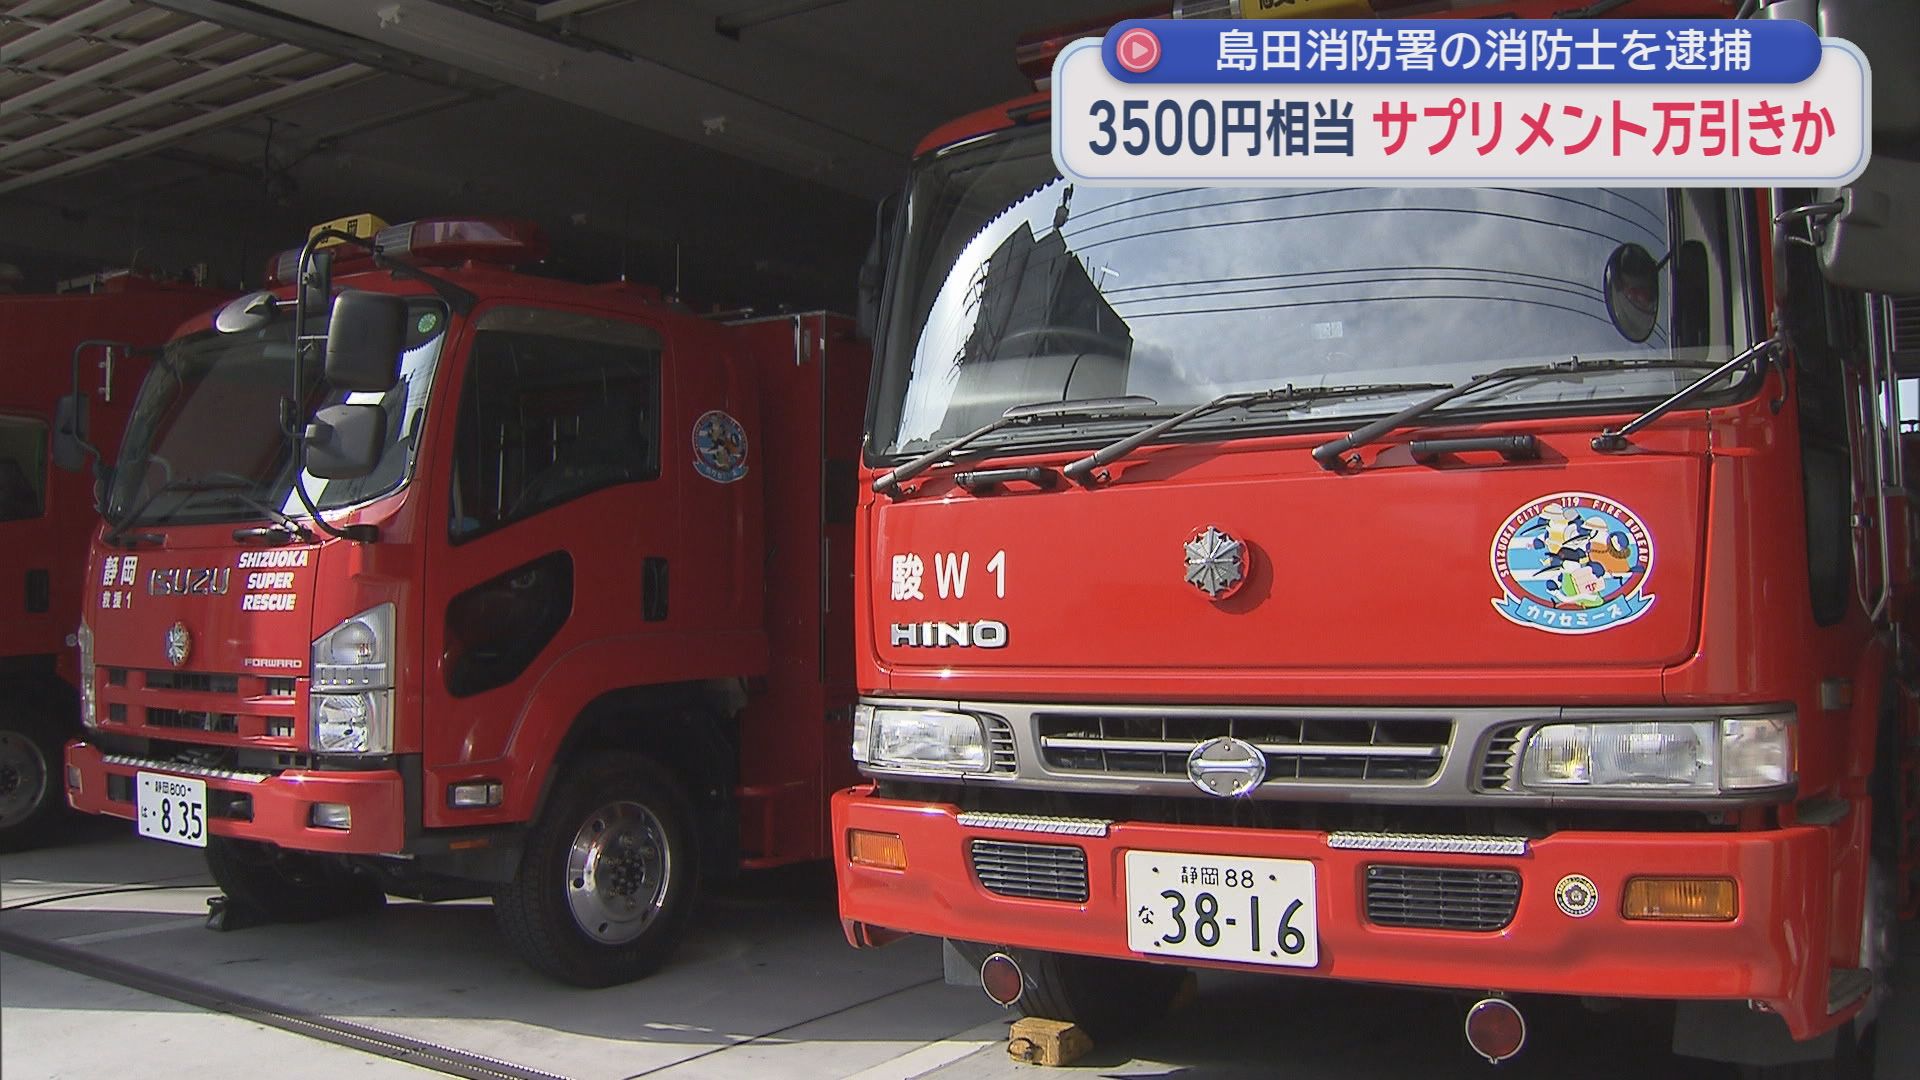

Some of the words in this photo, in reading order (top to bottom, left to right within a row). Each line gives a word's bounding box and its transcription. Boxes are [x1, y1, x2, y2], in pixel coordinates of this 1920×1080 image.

[1560, 496, 1580, 508] 119
[1592, 500, 1621, 518] FIRE
[238, 550, 309, 568] SHIZUOKA
[103, 556, 138, 586] 静岡
[148, 566, 231, 595] ISUZU
[247, 572, 294, 590] SUPER
[242, 593, 297, 612] RESCUE
[891, 620, 1008, 648] HINO
[244, 657, 302, 669] FORWARD
[1137, 905, 1155, 925] な
[1160, 889, 1306, 955] 38-16
